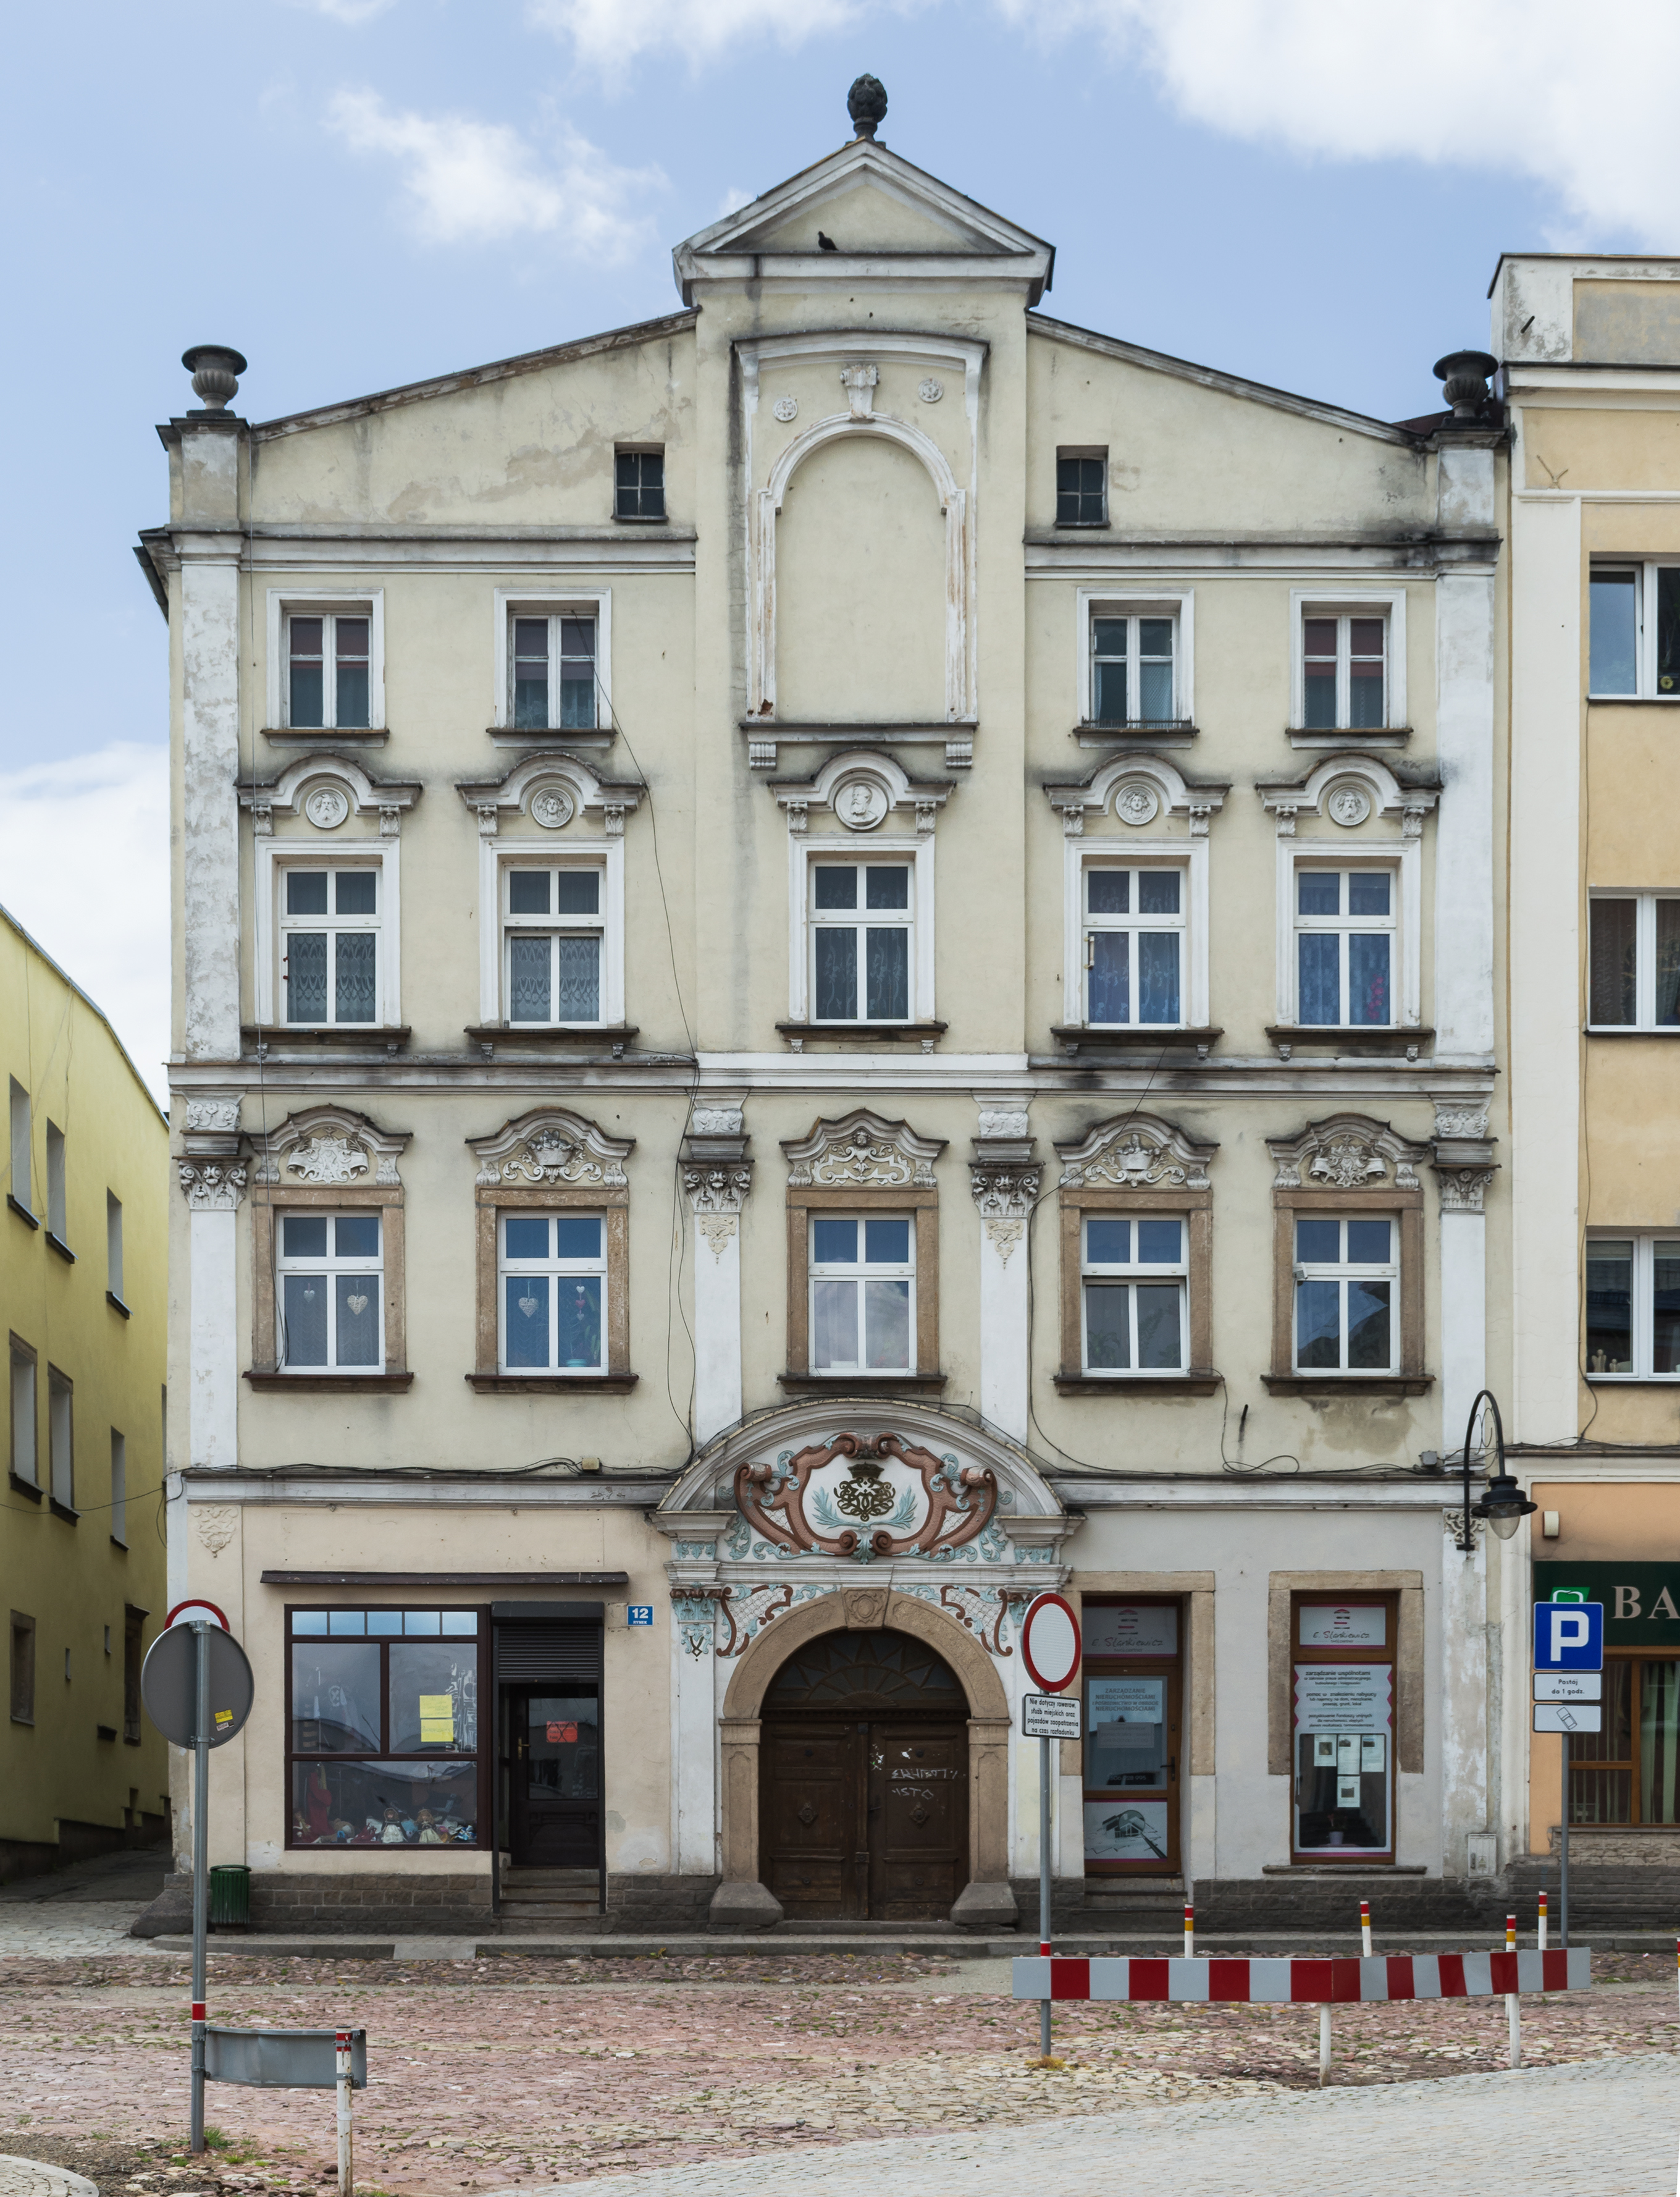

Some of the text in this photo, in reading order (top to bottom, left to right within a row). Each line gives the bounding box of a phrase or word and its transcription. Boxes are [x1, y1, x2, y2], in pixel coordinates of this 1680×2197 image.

[1611, 1585, 1680, 1619] BA
[632, 1608, 649, 1619] 12
[1550, 1611, 1589, 1661] P
[1039, 1699, 1056, 1708] dotyczy
[1057, 1701, 1077, 1709] rowerów,
[1044, 1708, 1064, 1718] miejskich
[1027, 1717, 1079, 1727] pojazdów zaopatrzenia
